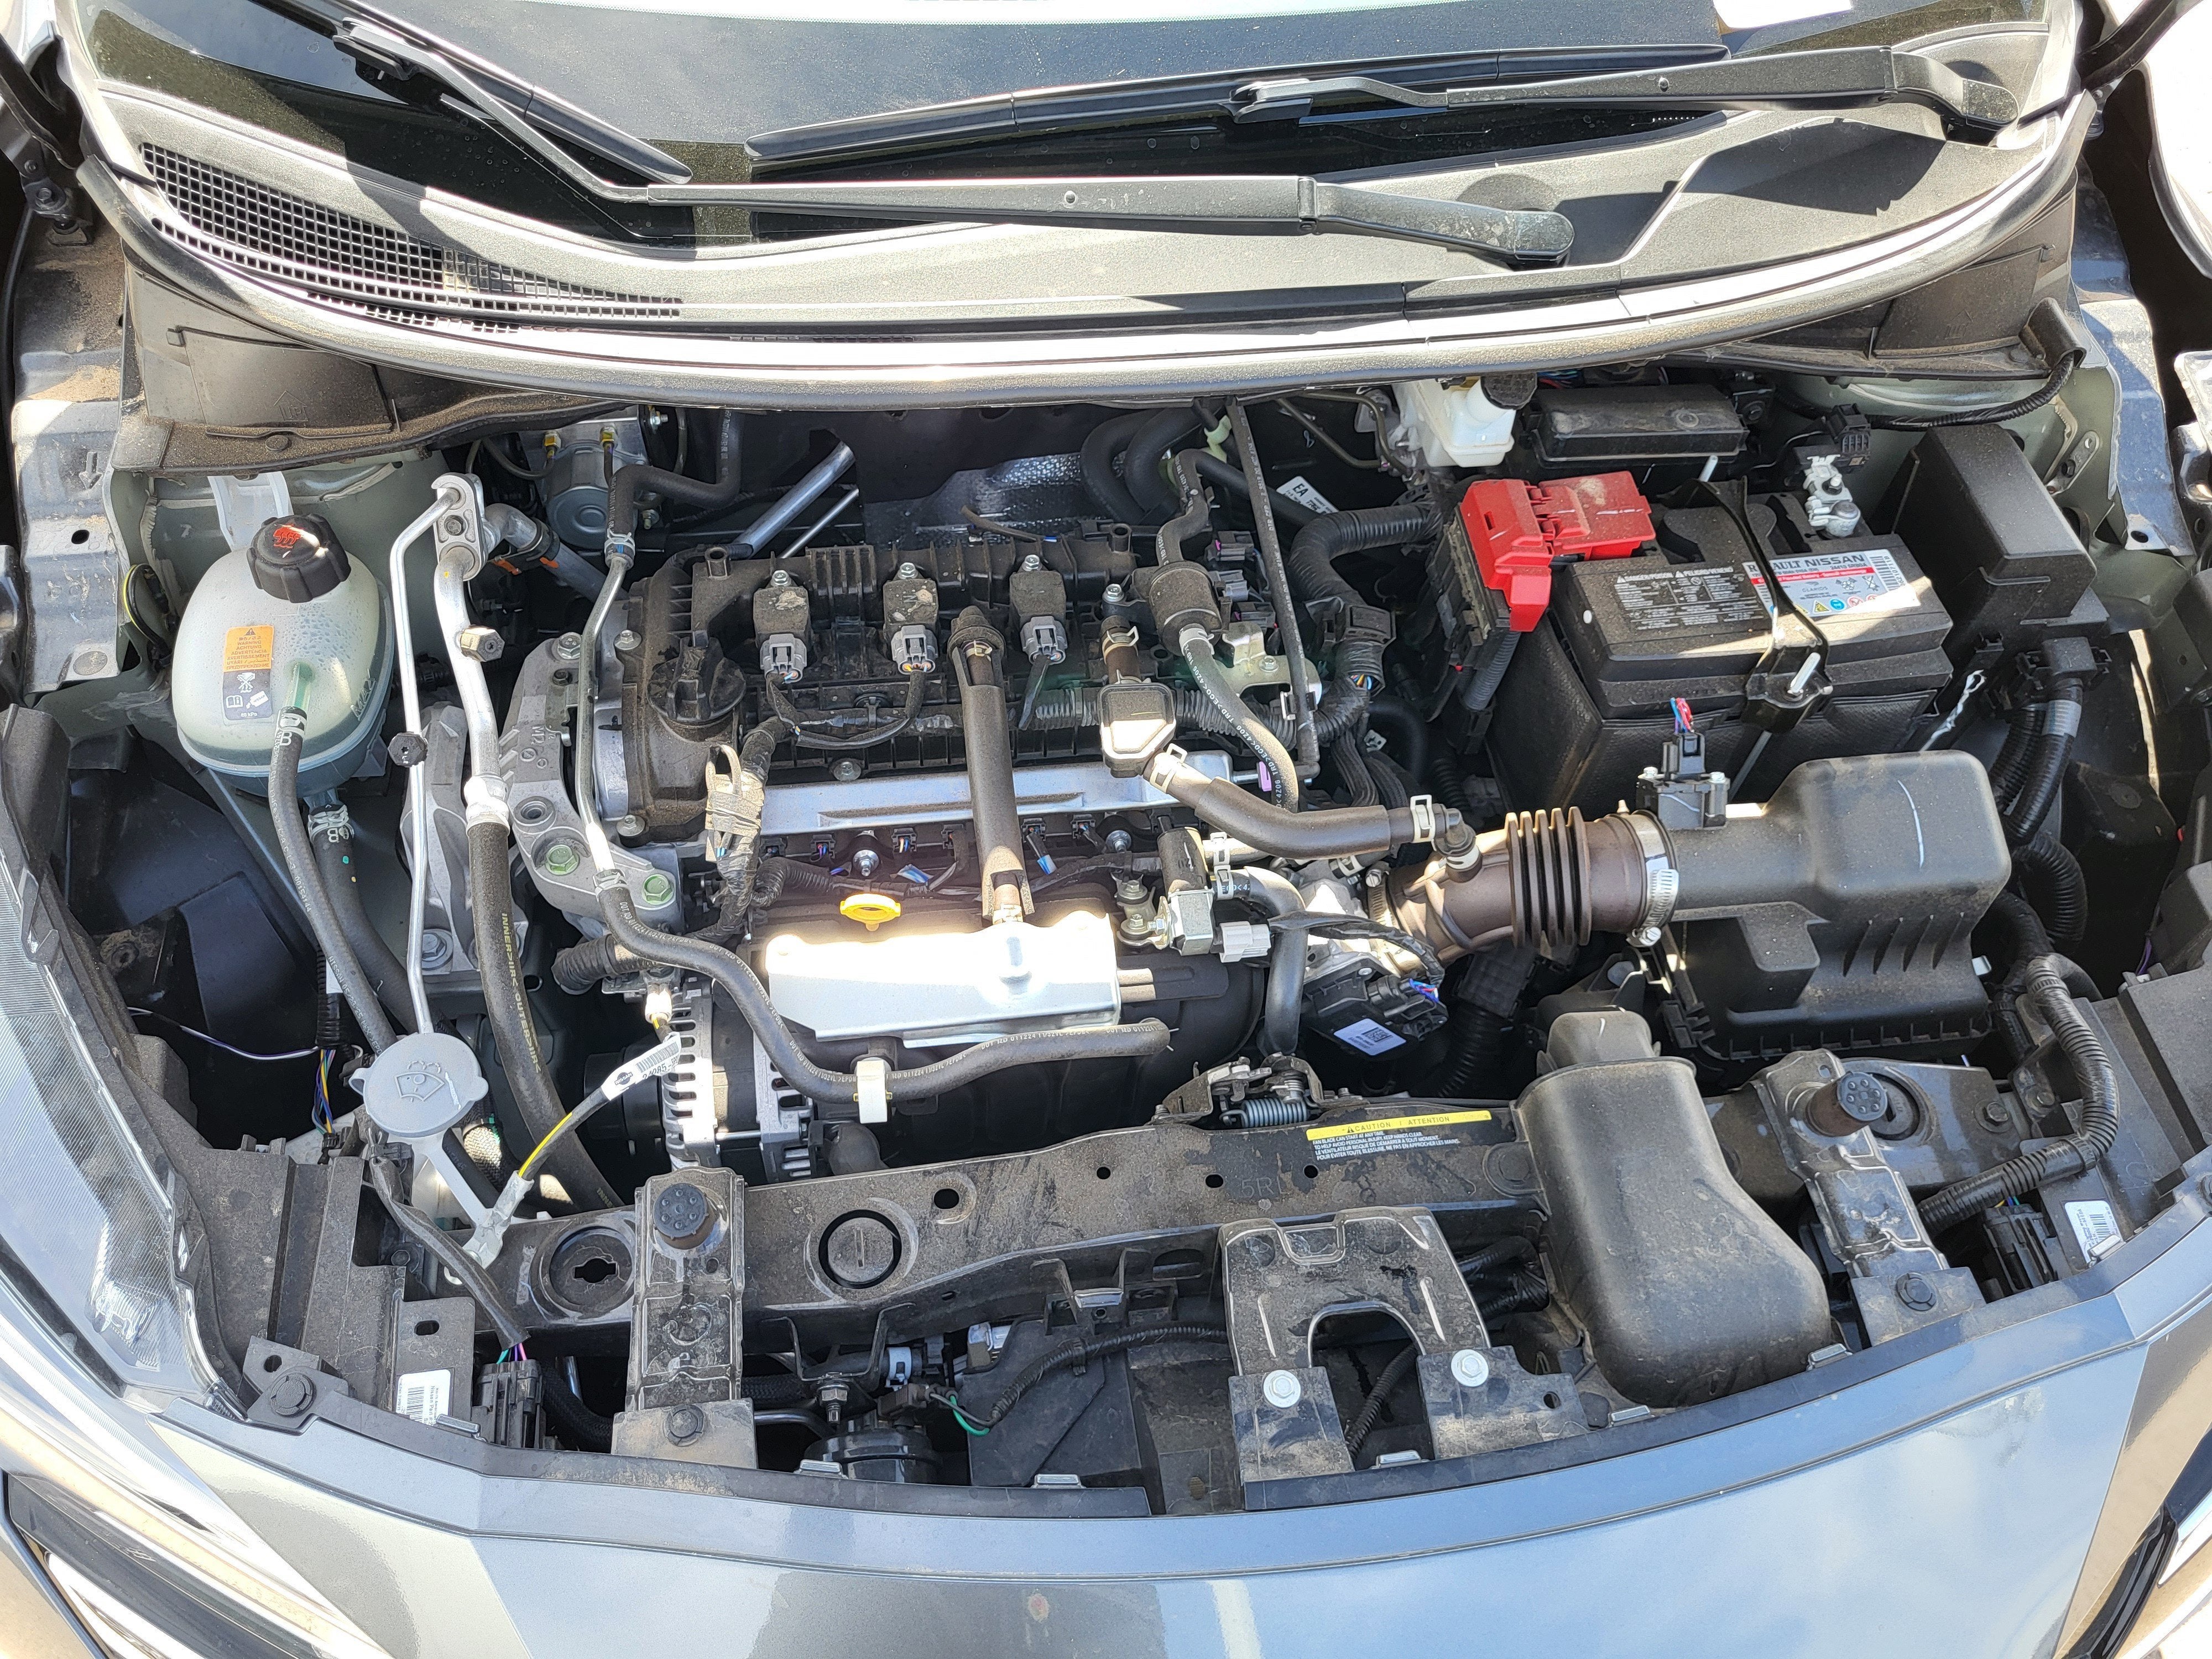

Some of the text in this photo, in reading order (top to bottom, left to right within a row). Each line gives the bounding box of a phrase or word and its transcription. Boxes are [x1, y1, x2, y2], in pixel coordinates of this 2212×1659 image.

[1292, 483, 1308, 497] EA
[1747, 560, 1801, 573] RAULT
[1804, 555, 1865, 567] NISSAN
[279, 731, 293, 746] B
[327, 955, 344, 983] NISSAN
[614, 1072, 633, 1086] NISSAN
[1355, 1122, 1391, 1131] CAUTION
[1408, 1117, 1449, 1125] ATTENTION
[1322, 1145, 1352, 1154] VENTILATEUR
